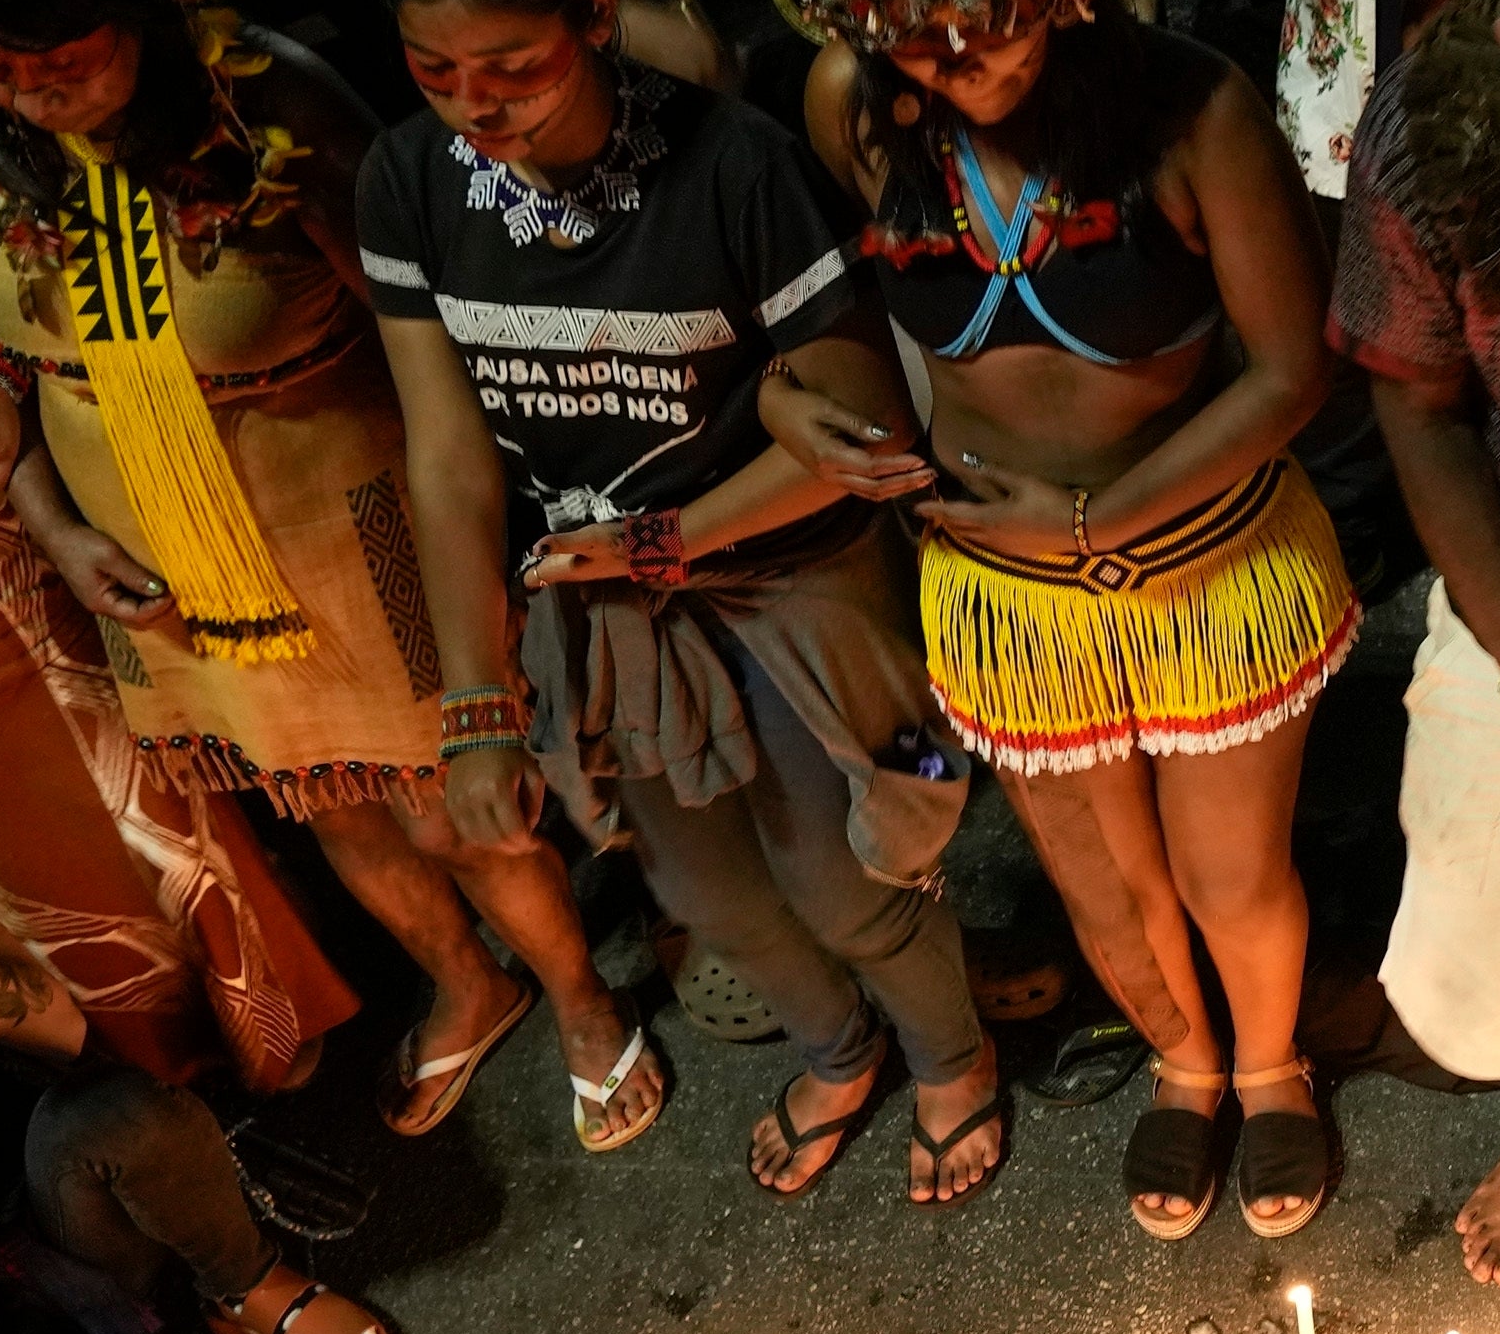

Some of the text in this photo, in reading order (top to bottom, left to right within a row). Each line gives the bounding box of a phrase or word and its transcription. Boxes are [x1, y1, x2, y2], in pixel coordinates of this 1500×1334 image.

[466, 355, 699, 394] AUSA INDÍGENA
[515, 391, 621, 419] TODOS
[626, 394, 689, 427] NÓS
